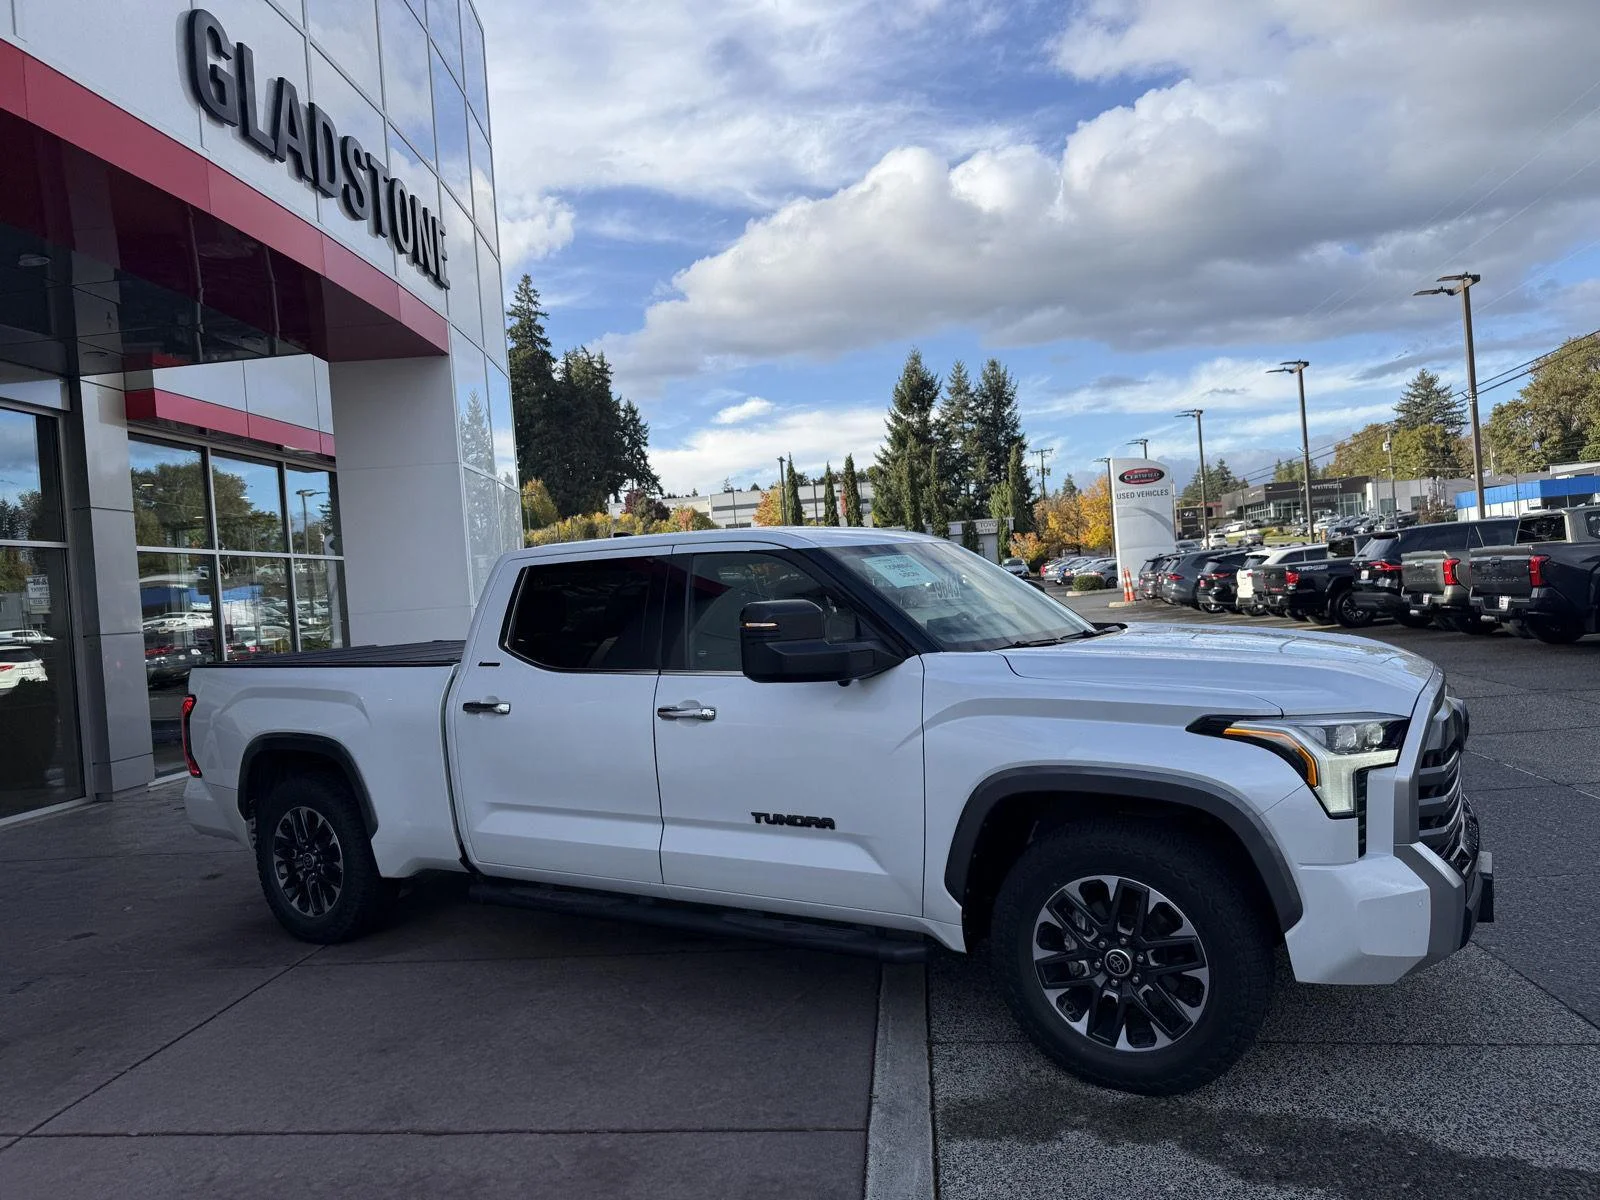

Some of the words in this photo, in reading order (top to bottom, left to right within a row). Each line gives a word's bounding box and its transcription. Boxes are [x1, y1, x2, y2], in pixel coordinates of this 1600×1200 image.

[187, 8, 451, 290] GLADSTONE
[1116, 491, 1135, 500] USED
[1137, 488, 1169, 498] VEHICLES
[751, 812, 836, 830] TUNDRA
